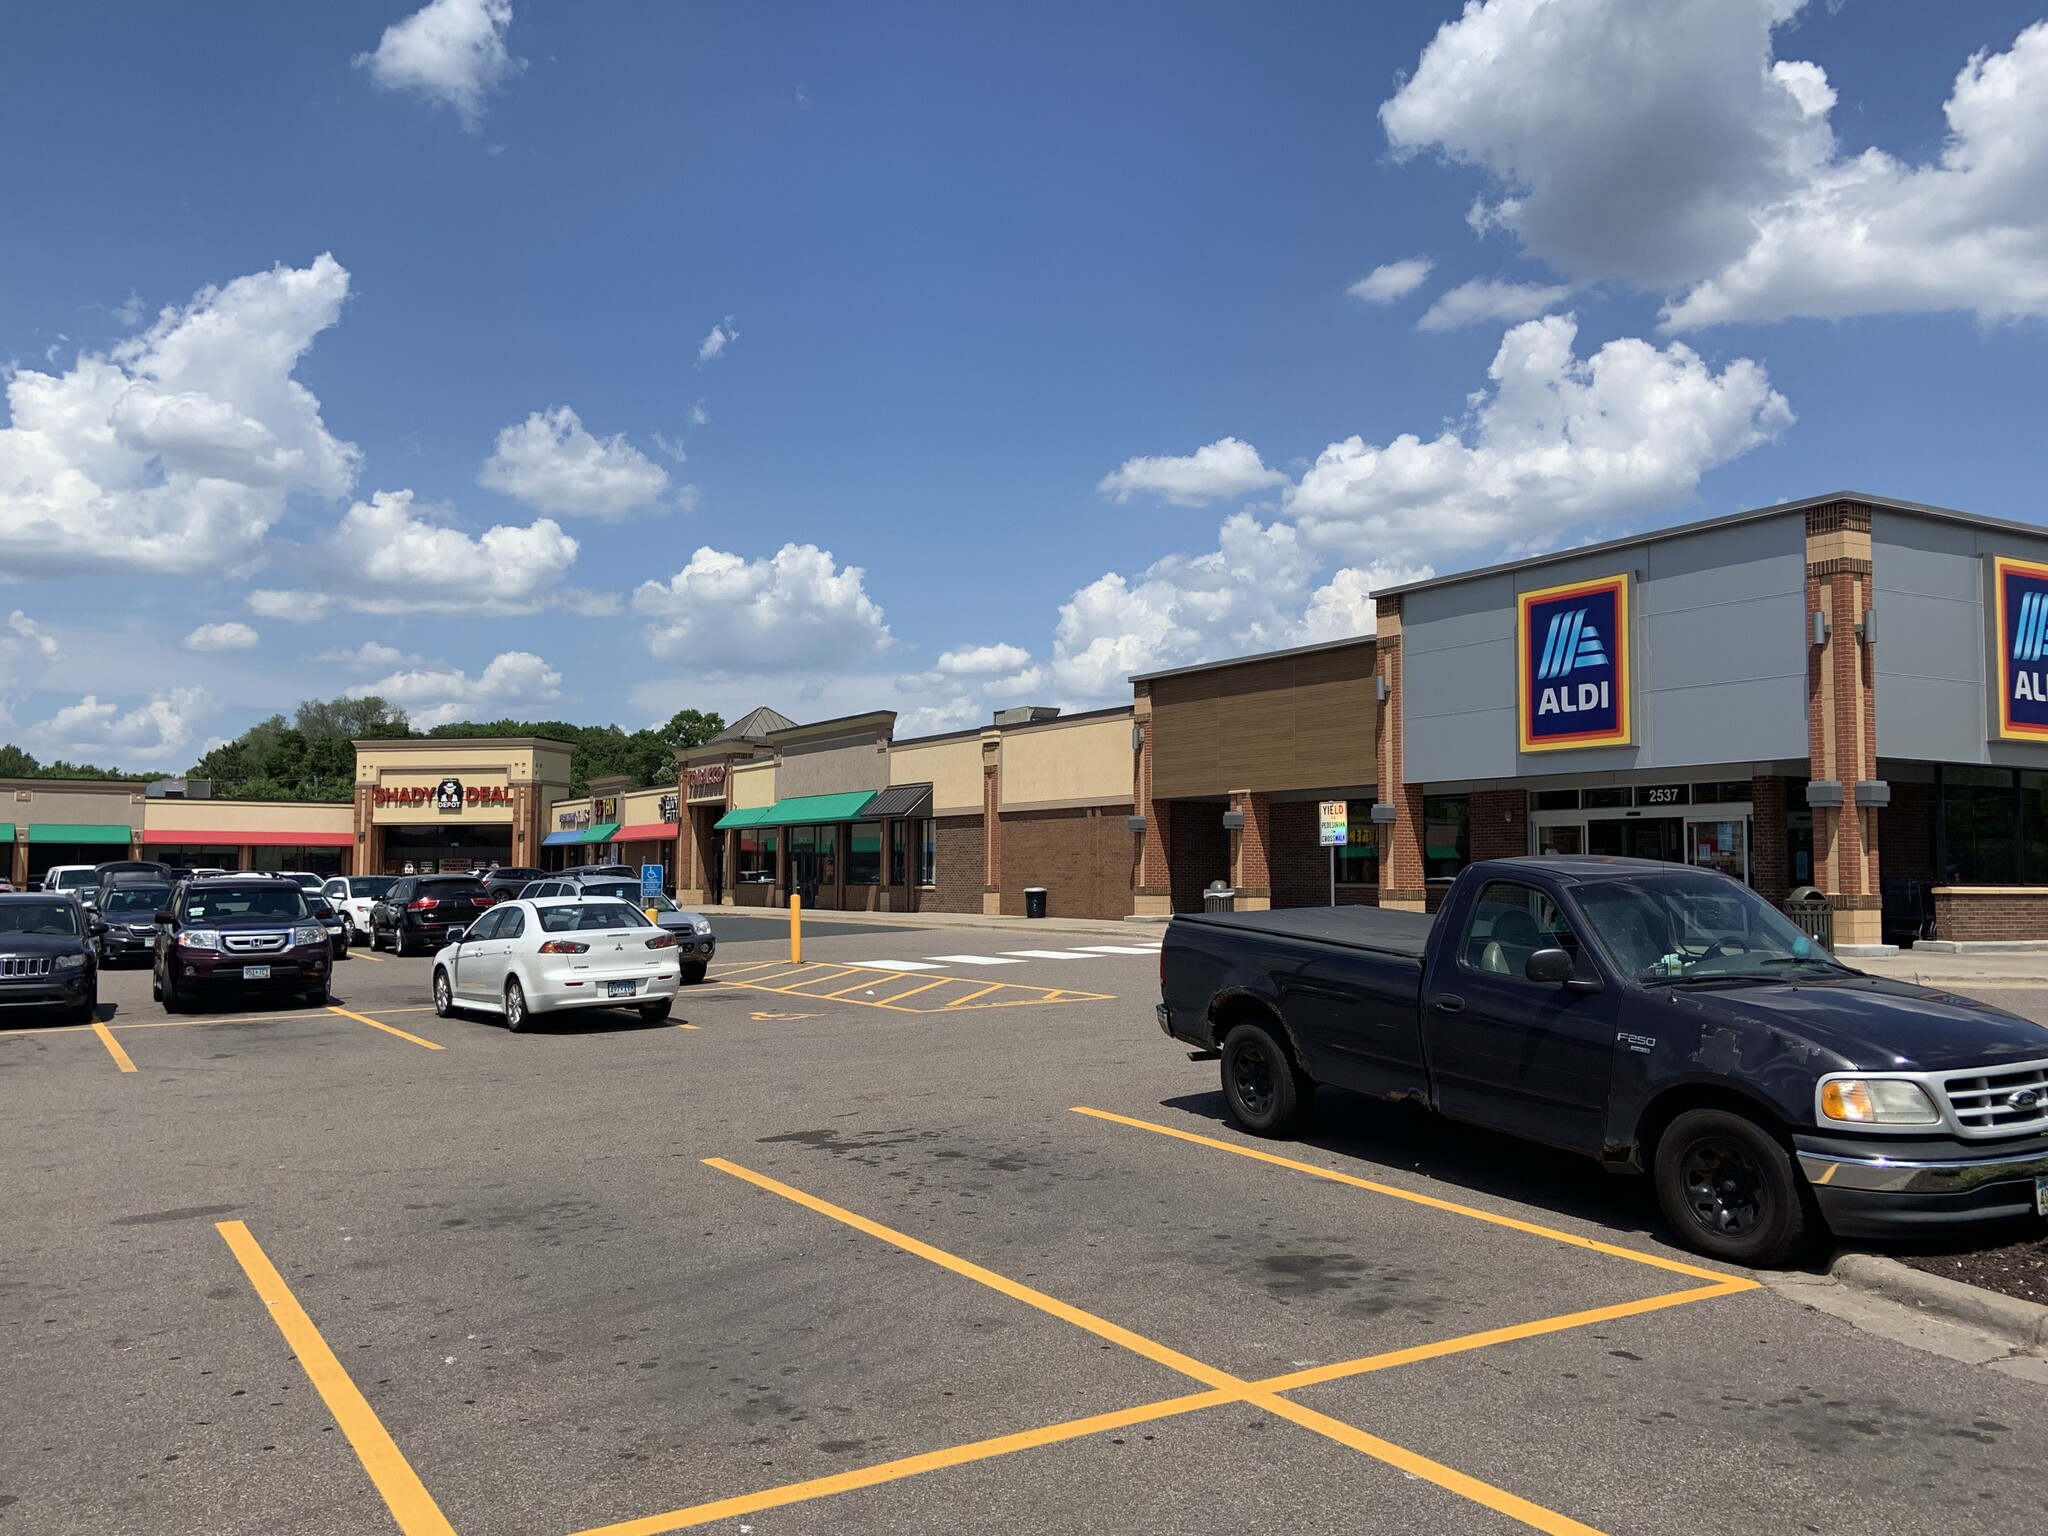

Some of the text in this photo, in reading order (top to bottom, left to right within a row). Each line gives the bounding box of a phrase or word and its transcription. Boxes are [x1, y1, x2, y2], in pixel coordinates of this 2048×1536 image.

[2014, 670, 2048, 702] AL
[1538, 681, 1609, 715] ALDI
[686, 766, 725, 786] TOBACCO
[374, 786, 513, 803] SHADY DEAL
[1649, 789, 1679, 802] 2537
[1322, 805, 1344, 815] YIELD
[1321, 835, 1345, 843] CROSSWALK
[1617, 1032, 1656, 1047] F250
